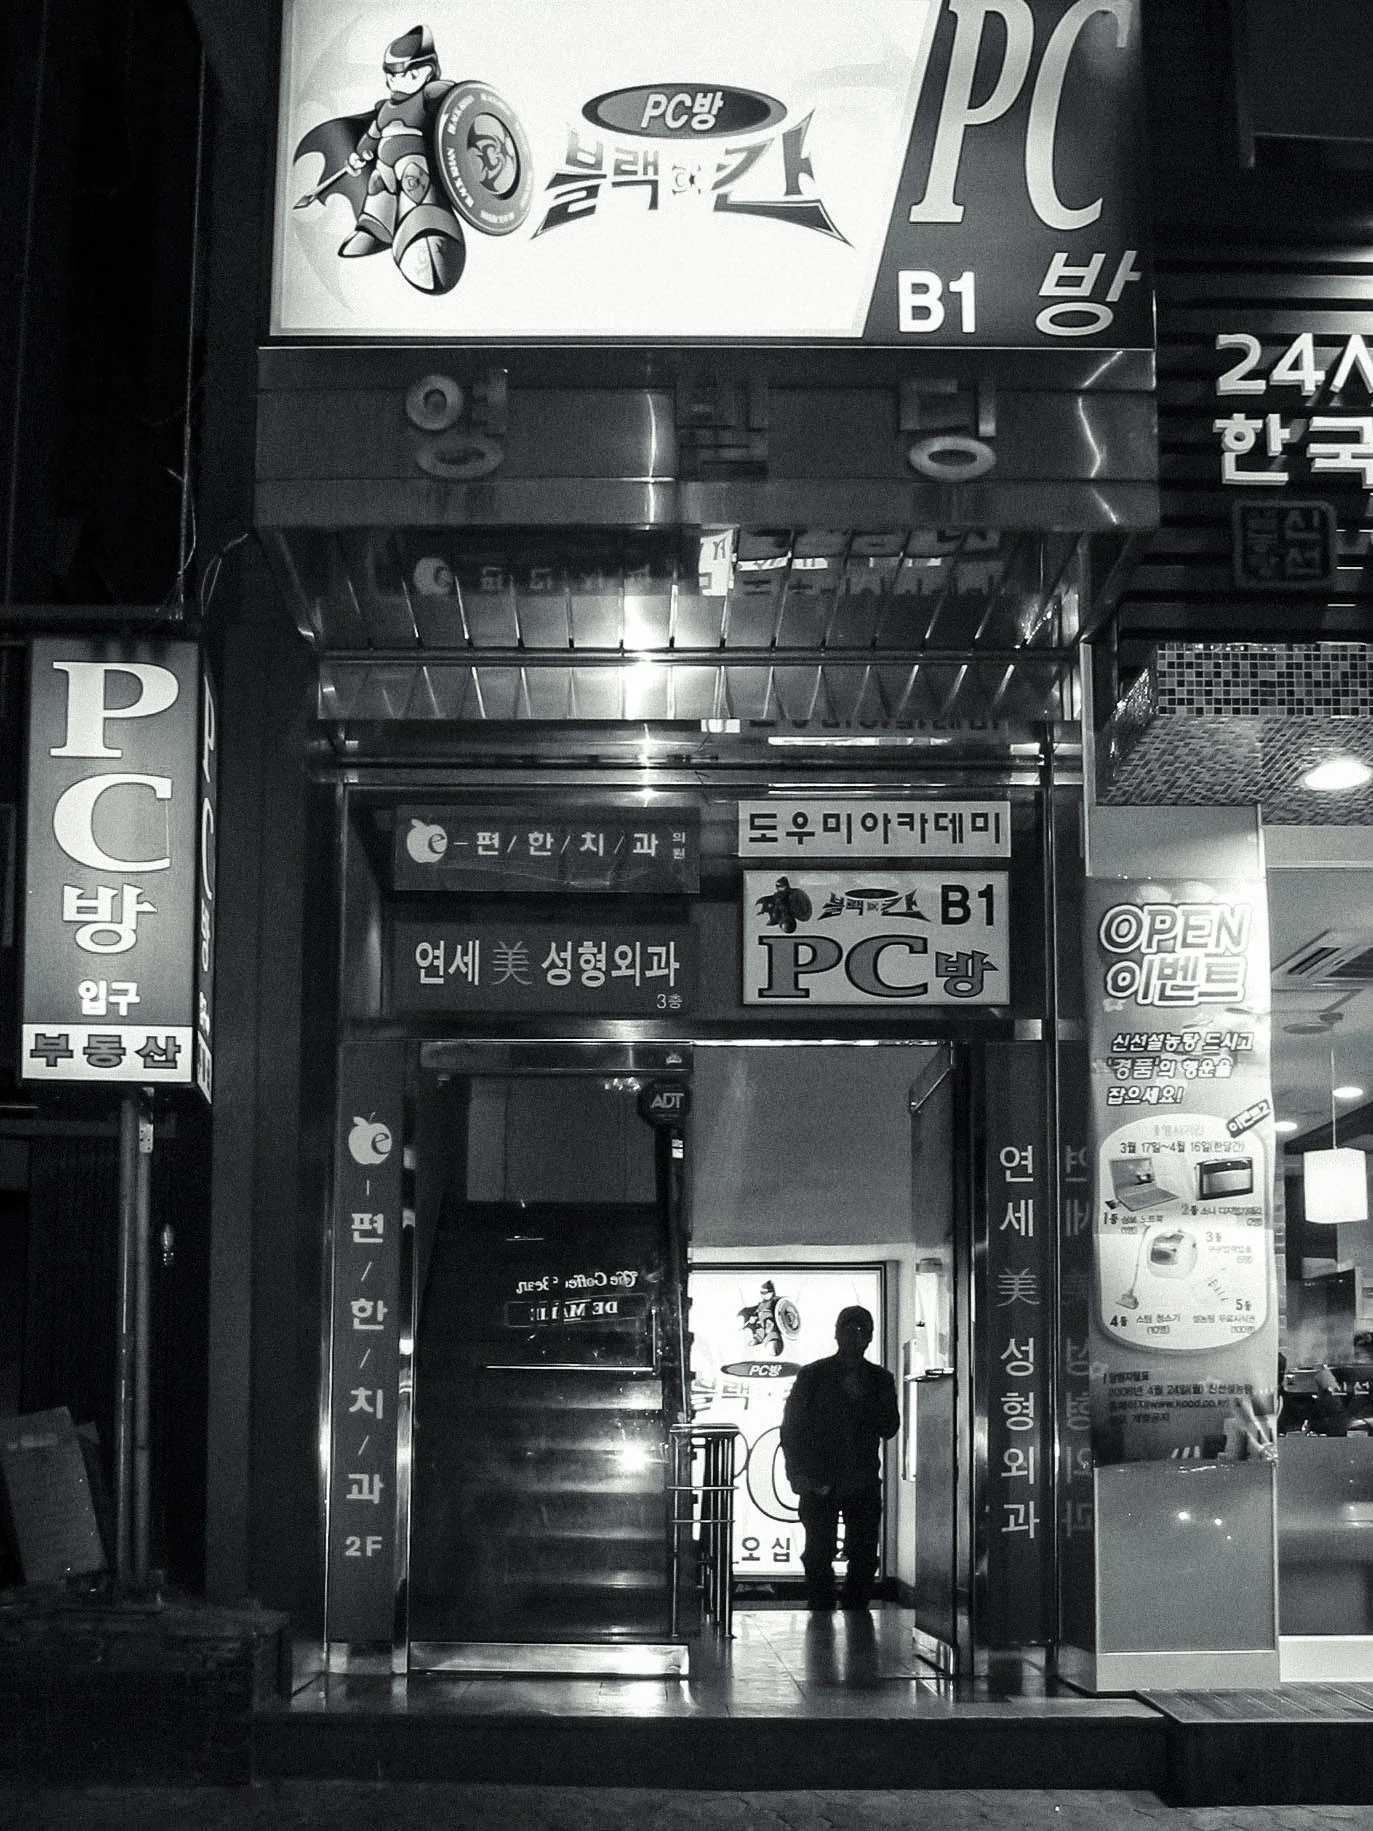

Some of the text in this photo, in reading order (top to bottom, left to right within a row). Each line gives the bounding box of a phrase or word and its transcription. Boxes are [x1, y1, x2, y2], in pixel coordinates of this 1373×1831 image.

[641, 92, 723, 131] PC방
[909, 0, 1133, 231] PC
[898, 269, 977, 335] B1
[748, 811, 1001, 845] 도우미아카데미
[941, 884, 994, 926] B1
[1100, 903, 1252, 953] OPEN
[415, 940, 680, 988] 연세 美 성형외과
[758, 934, 999, 998] PC방
[1106, 954, 1247, 1006] 이벤트
[78, 980, 141, 1016] 입구
[656, 993, 683, 1009] 3층
[30, 1033, 181, 1069] 부동산
[1112, 1031, 1254, 1052] 신선설농탕 드시고
[1181, 1058, 1233, 1079] 행운을
[650, 1092, 684, 1109] ADT
[1107, 1085, 1184, 1106] 잡으세요!
[996, 1145, 1040, 1539] 연세 美 성형외과
[749, 1364, 782, 1377] PC방
[344, 1535, 382, 1556] 2F
